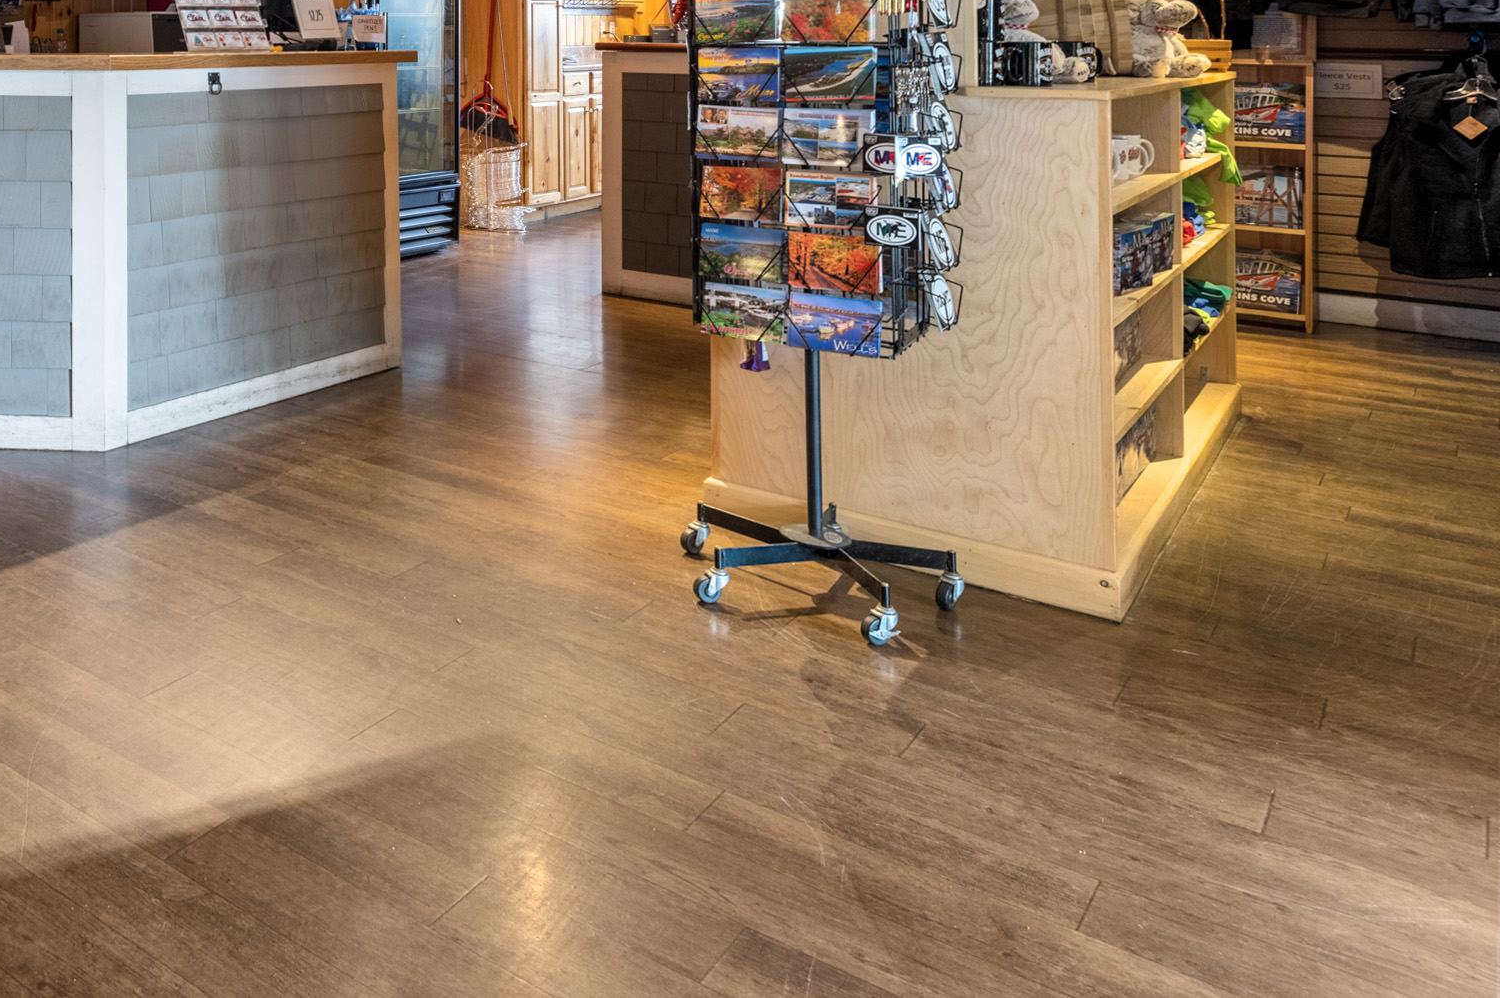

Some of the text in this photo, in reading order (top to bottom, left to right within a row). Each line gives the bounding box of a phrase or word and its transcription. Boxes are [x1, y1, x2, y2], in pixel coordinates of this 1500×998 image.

[1345, 72, 1372, 81] Vests
[1333, 82, 1352, 91] $25
[1261, 127, 1292, 137] COVE
[1260, 294, 1292, 306] COVE
[833, 339, 878, 355] WELLS
